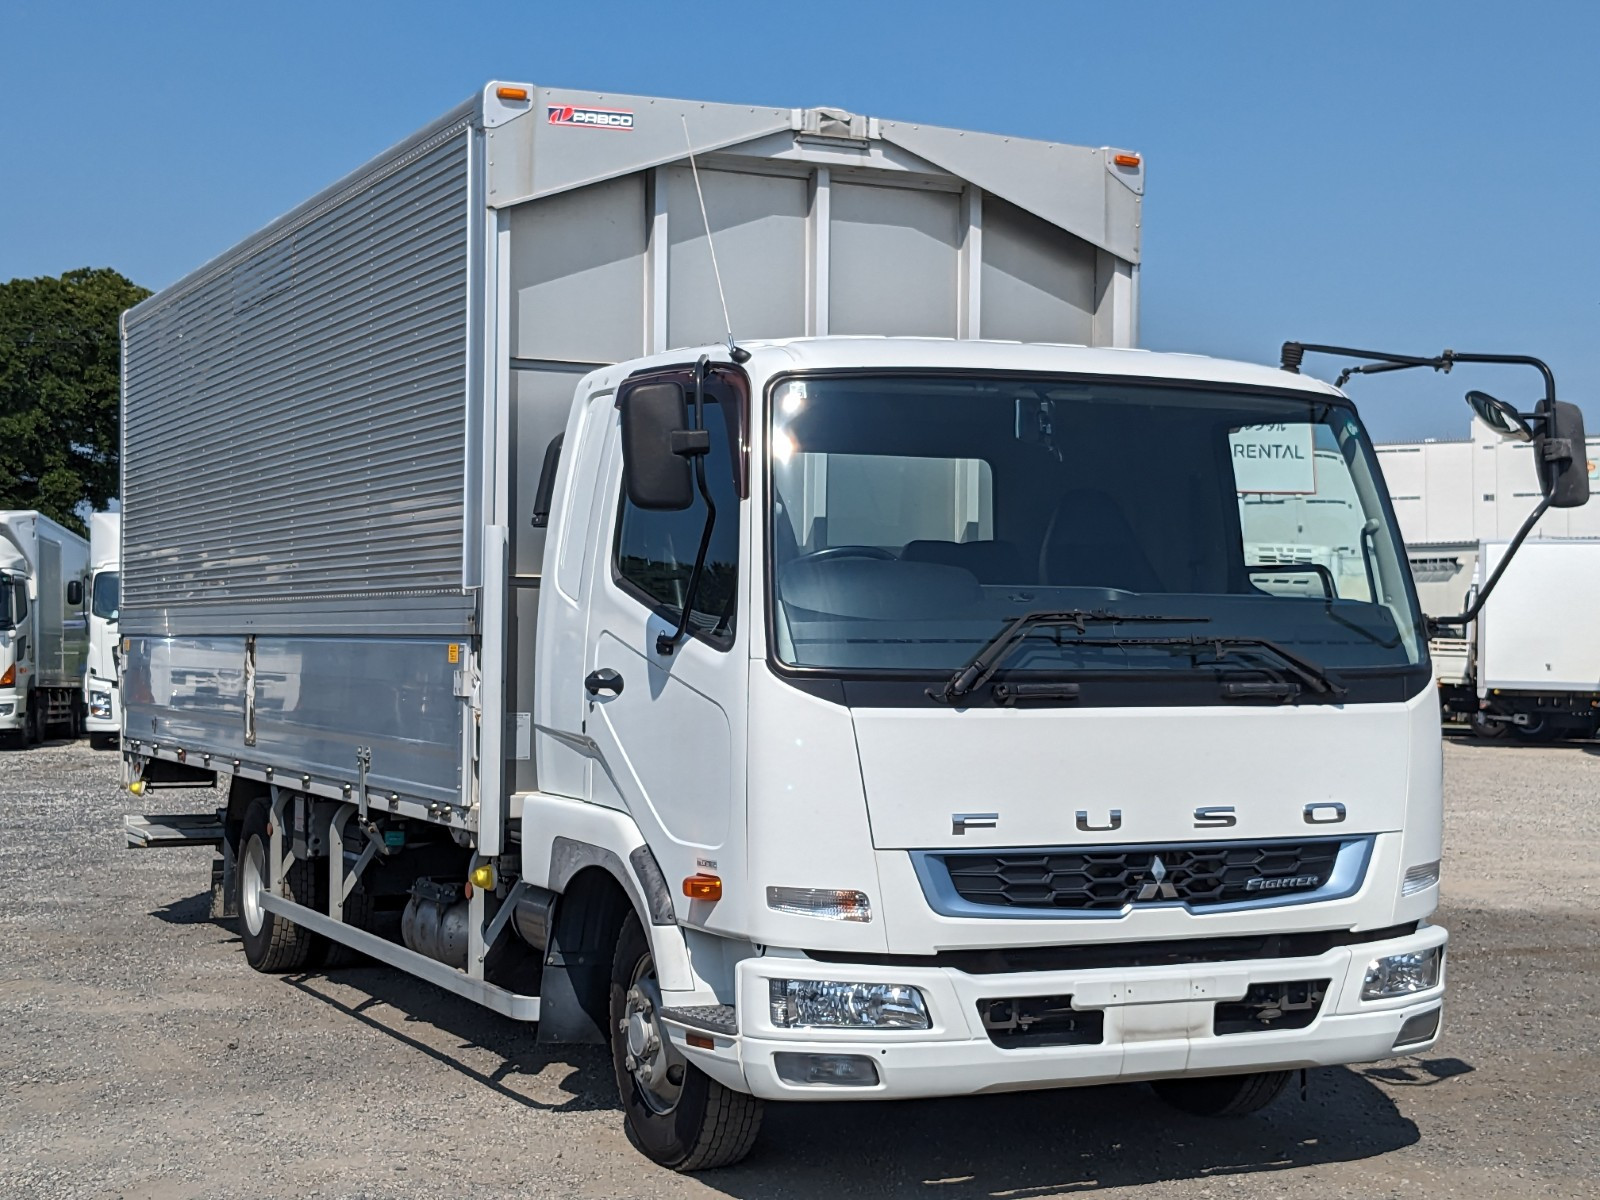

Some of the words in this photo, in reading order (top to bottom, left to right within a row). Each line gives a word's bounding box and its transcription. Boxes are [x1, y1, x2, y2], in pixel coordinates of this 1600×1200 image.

[573, 112, 633, 126] PABCO
[1233, 443, 1305, 460] RENTAL
[952, 802, 1346, 836] FUSO
